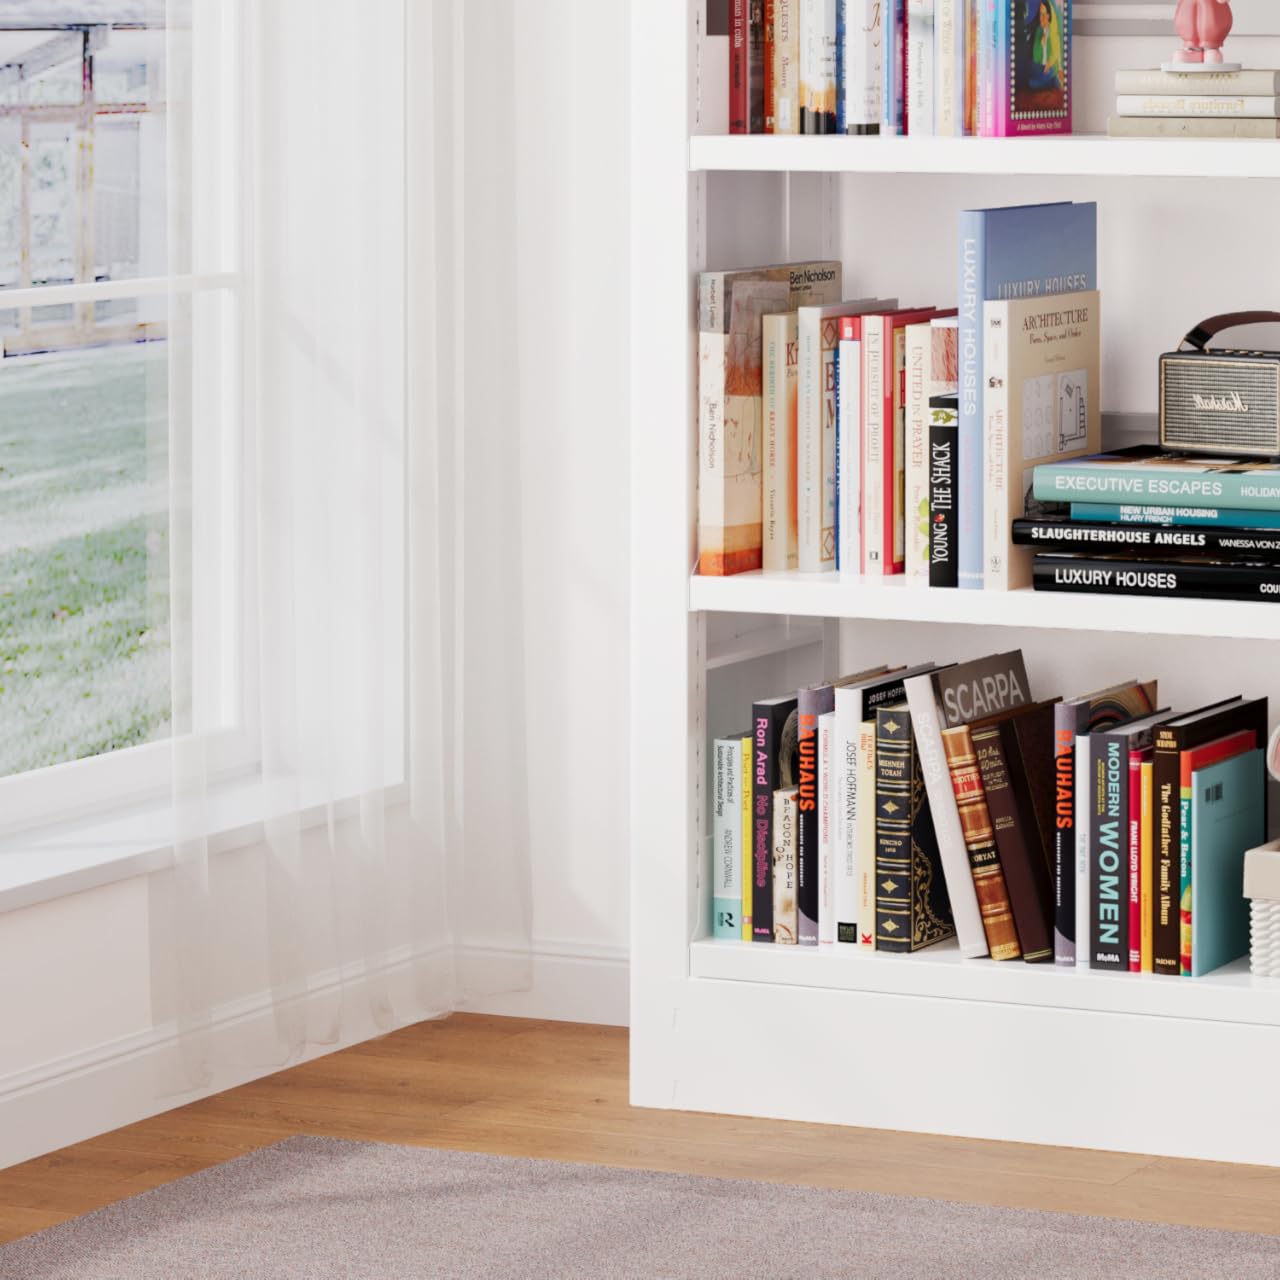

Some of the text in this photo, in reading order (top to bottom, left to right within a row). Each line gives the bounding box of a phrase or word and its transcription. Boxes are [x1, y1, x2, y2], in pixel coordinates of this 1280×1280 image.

[734, 0, 743, 17] man
[734, 18, 743, 27] in
[734, 28, 743, 48] cuba
[790, 269, 836, 285] Ben Nicholson
[963, 239, 976, 321] LUXURY
[998, 274, 1087, 299] LUXURY HOUSES
[1022, 307, 1089, 331] ARCHITECTURE
[868, 351, 881, 399] PURSUIT
[963, 329, 976, 416] HOUSES
[912, 347, 923, 468] UNITED IN PRAYER
[708, 403, 718, 469] Ben Nicholson
[931, 441, 952, 511] THE SHACK
[1055, 476, 1223, 496] EXECUTIVE ESCAPES
[1120, 505, 1218, 519] NEW URBAN HOUSING
[931, 523, 949, 564] YOUNG
[1031, 527, 1206, 546] SLAUGHTERHOUSE ANGELS
[1219, 538, 1255, 549] VANESSA
[1256, 540, 1276, 550] VON
[1055, 568, 1177, 588] LUXURY HOUSES
[944, 669, 1025, 723] SCARPA
[756, 718, 769, 785] Ron Arad
[800, 714, 815, 811] BAUHAUS
[880, 768, 902, 777] TORAH
[847, 740, 857, 821] JOSEF HOFFMANN
[1055, 730, 1072, 828] BAUHAUS
[724, 829, 733, 855] ANDREW
[756, 795, 769, 888] No Discipline
[1099, 743, 1119, 943] MODERN WOMEN
[1160, 783, 1171, 925] The Godfather Family Album
[1181, 800, 1189, 878] Pear & Bacon
[785, 854, 793, 889] HOPE
[1130, 820, 1138, 903] FRANK LLOYD WRIGHT
[1097, 953, 1120, 963] MoMA
